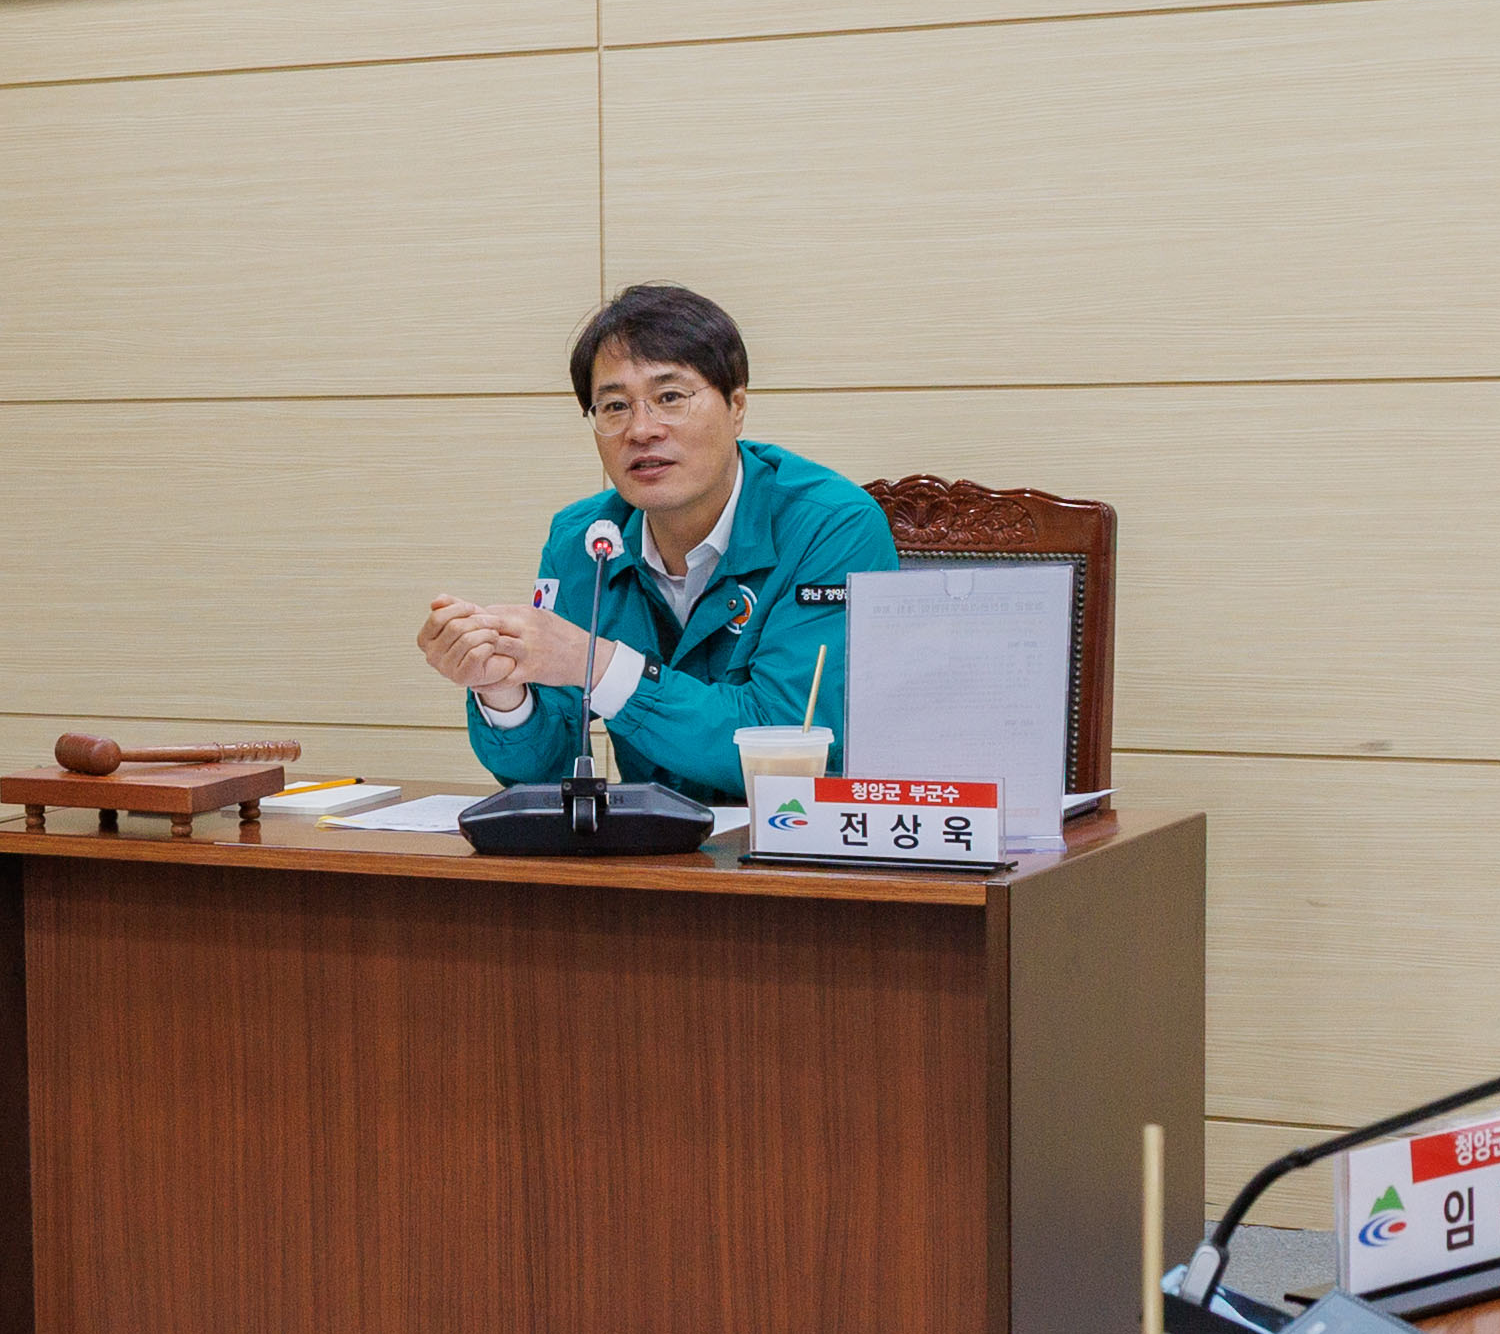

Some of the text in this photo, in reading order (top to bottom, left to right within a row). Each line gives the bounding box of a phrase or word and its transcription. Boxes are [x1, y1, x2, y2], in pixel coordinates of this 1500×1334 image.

[801, 588, 822, 601] 충남
[851, 782, 960, 803] 청양군 부군수
[839, 812, 973, 851] 전상욱
